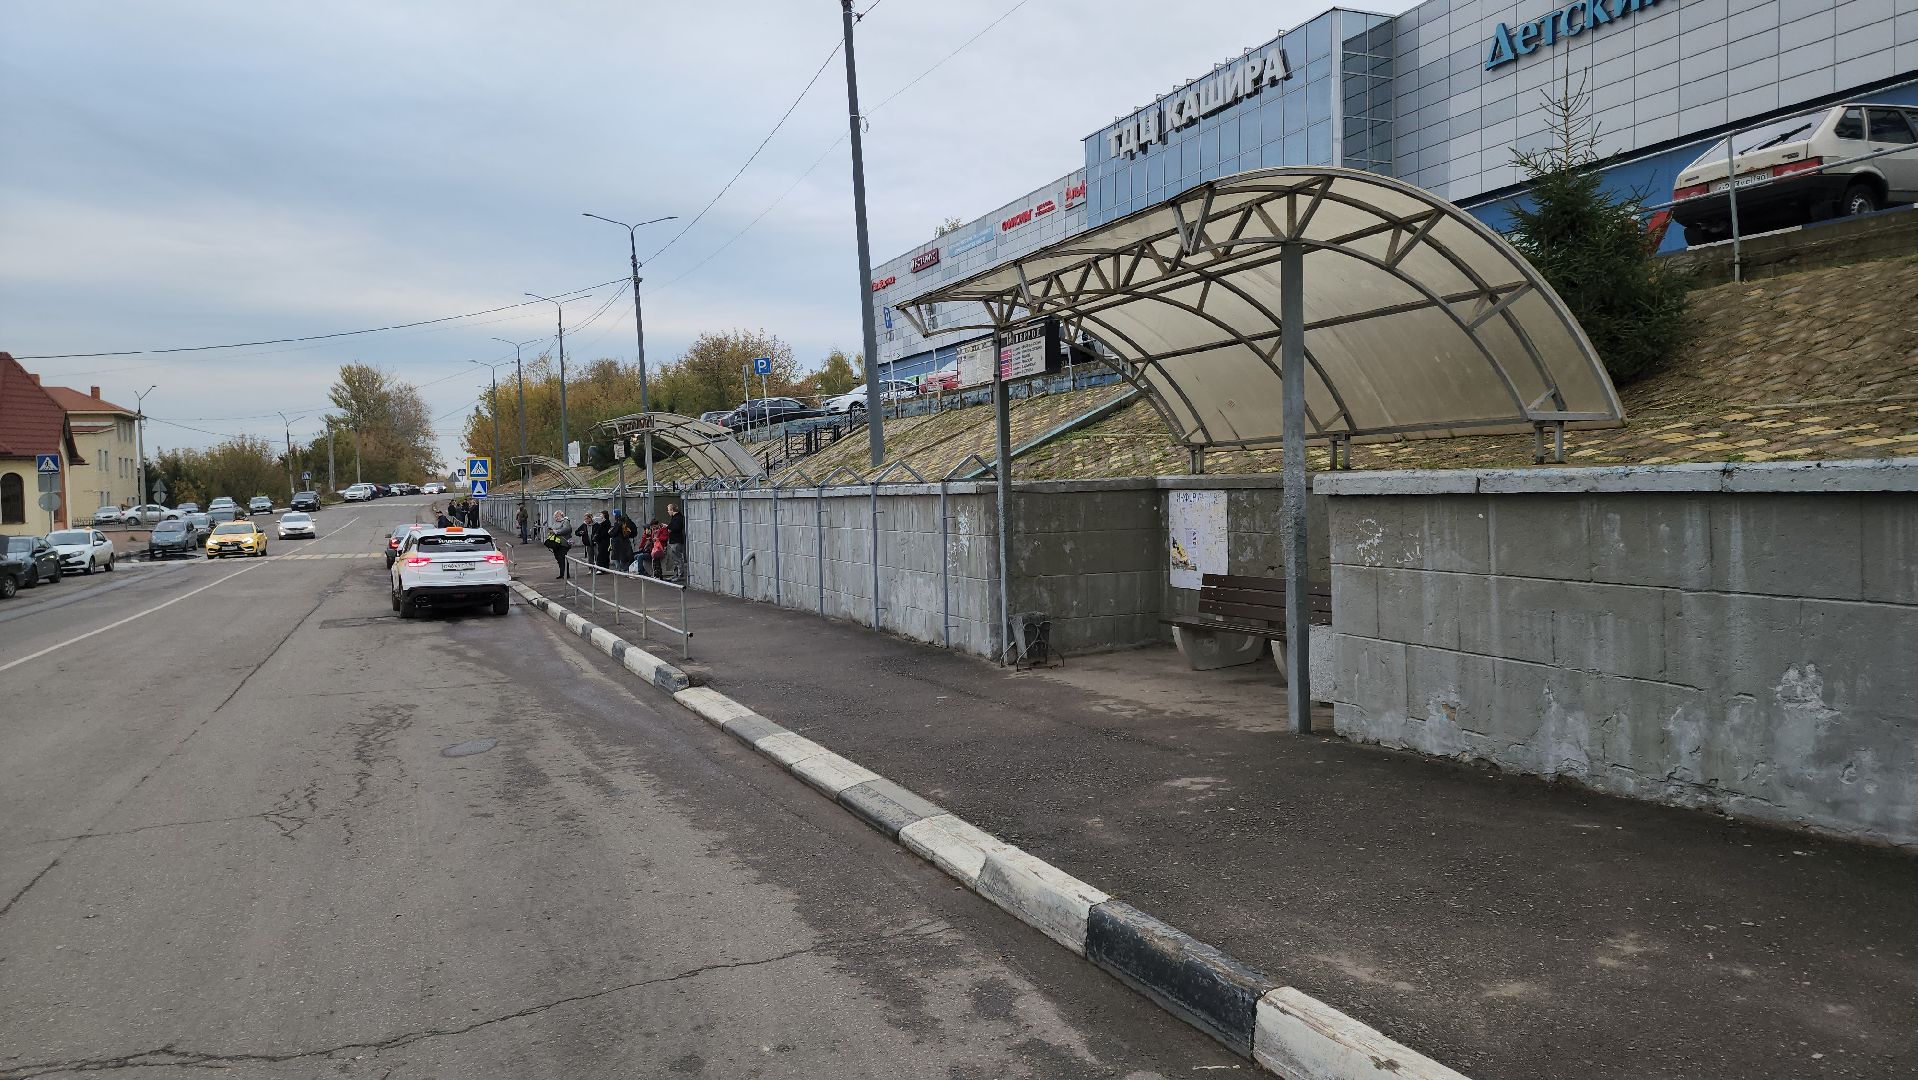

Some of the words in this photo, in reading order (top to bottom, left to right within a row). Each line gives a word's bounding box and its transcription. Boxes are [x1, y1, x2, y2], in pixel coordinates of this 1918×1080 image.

[1485, 0, 1655, 71] Детск
[1107, 106, 1164, 159] ТДЦ
[1165, 48, 1290, 131] КАШИРА
